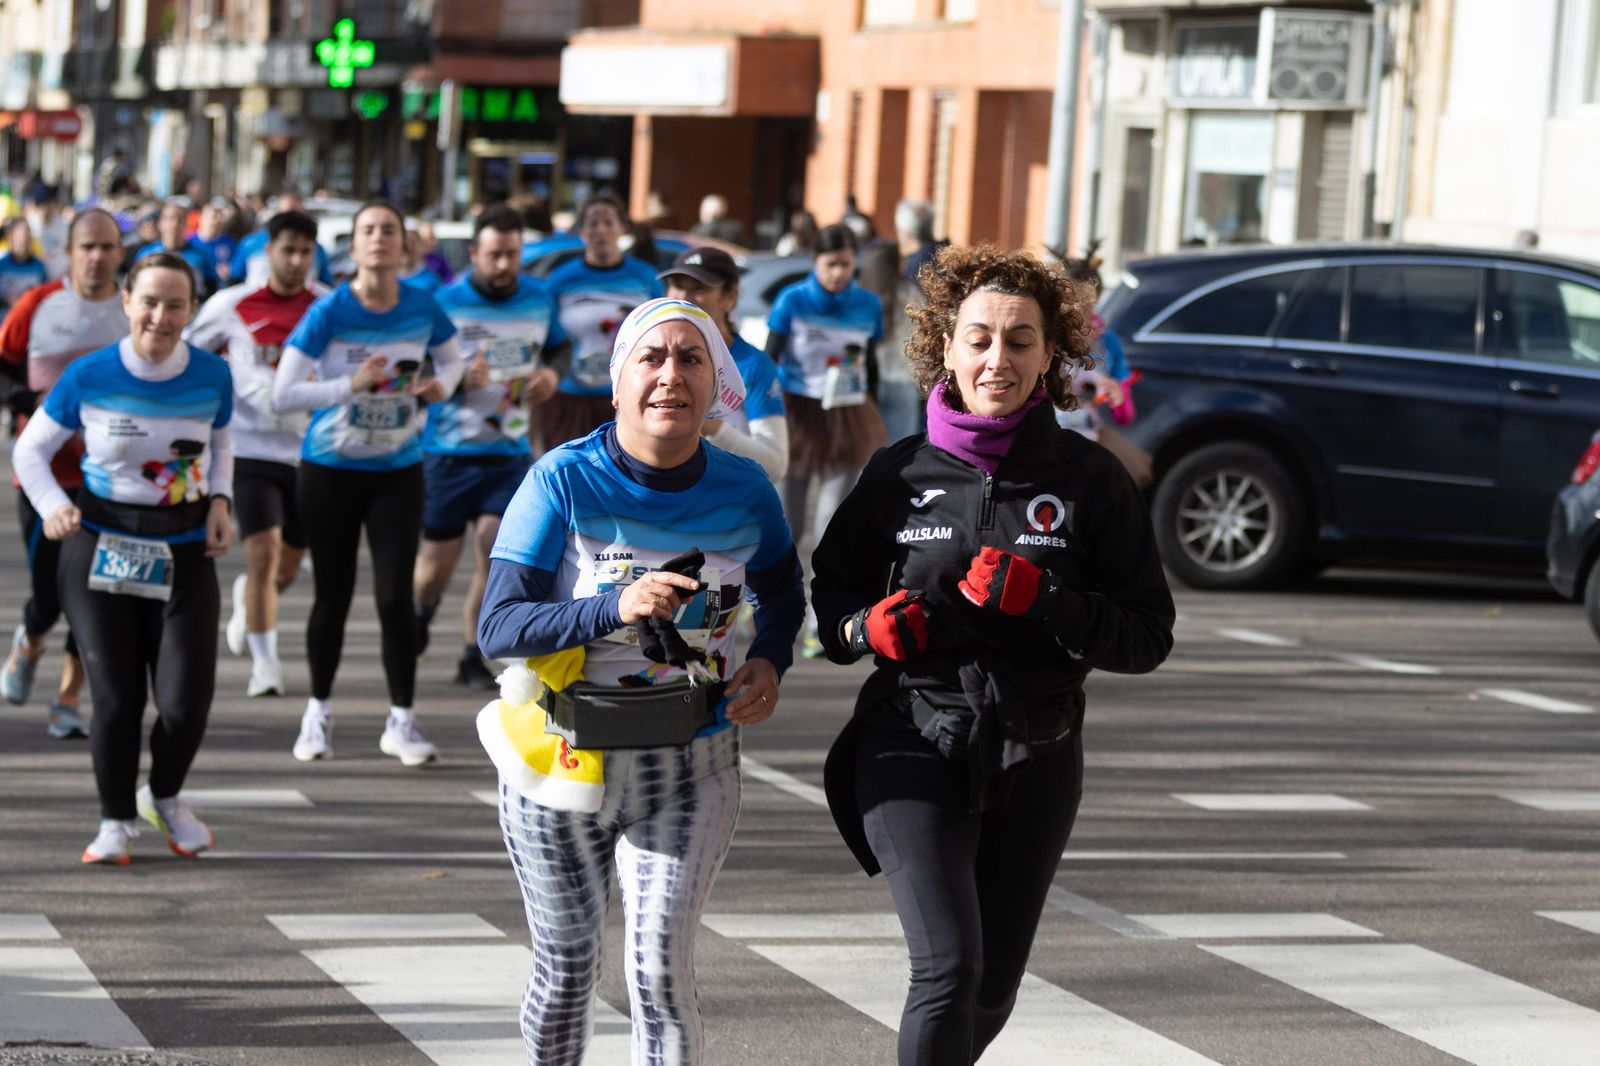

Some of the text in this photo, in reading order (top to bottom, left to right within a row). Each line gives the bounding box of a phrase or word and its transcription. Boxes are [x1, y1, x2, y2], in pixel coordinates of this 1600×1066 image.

[102, 550, 156, 581] 3327
[594, 552, 633, 562] XLI SAN
